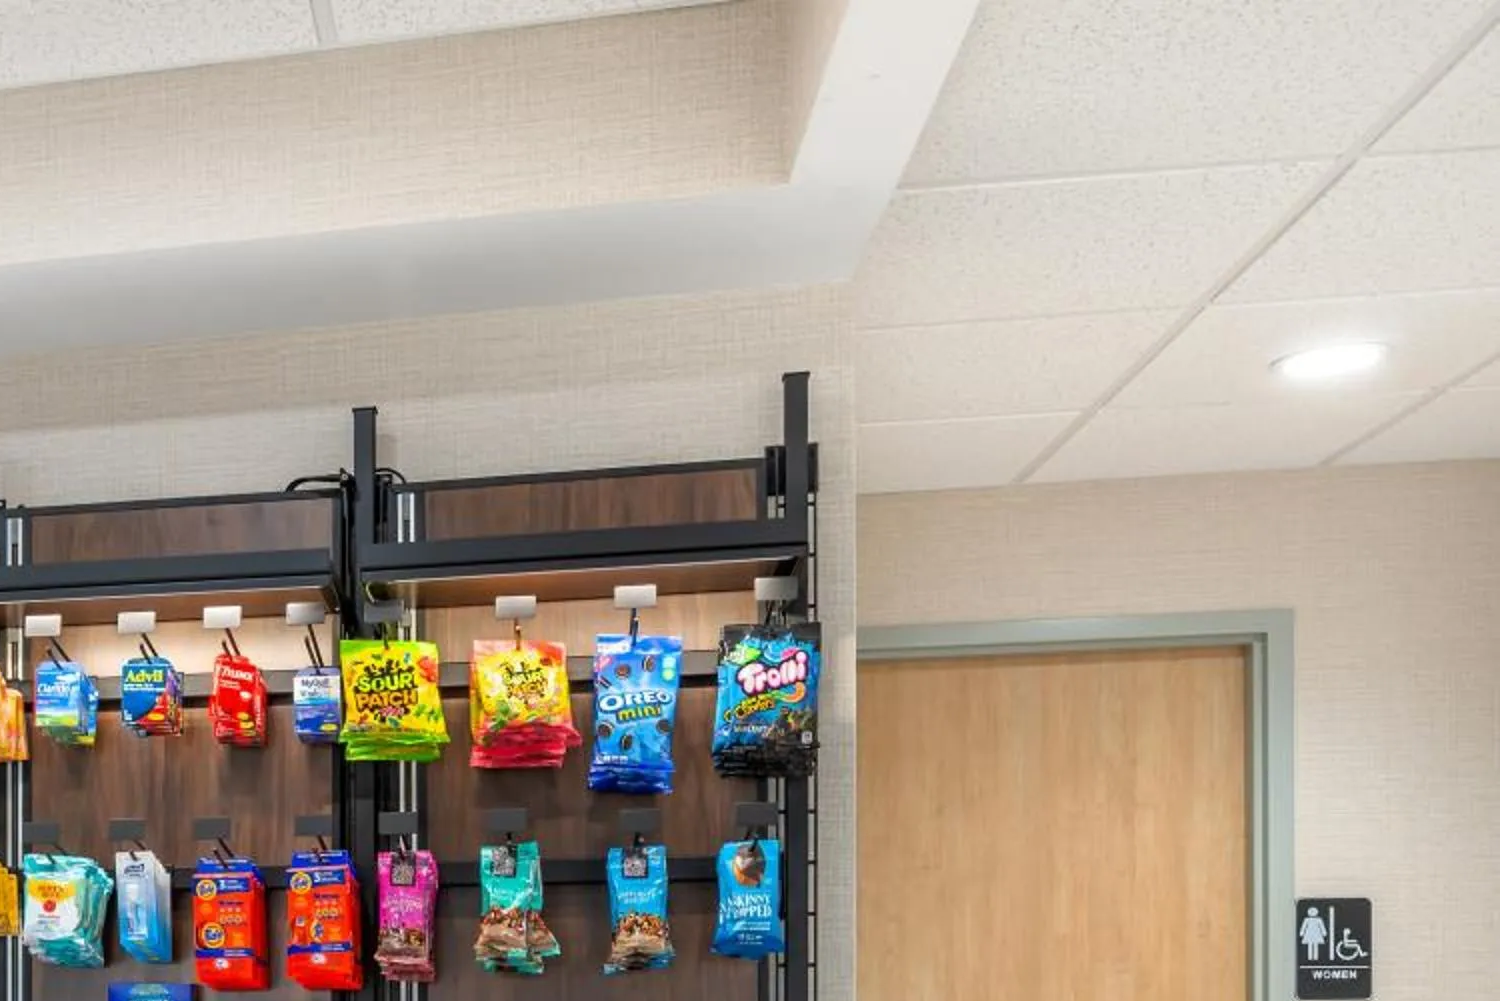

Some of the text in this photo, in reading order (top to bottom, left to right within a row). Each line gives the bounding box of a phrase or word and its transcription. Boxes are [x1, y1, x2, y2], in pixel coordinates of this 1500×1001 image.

[125, 669, 165, 684] Advil
[356, 672, 414, 692] SOUR
[737, 651, 808, 695] Trolli
[355, 690, 417, 708] PATCH
[600, 688, 674, 711] OREO
[617, 704, 662, 723] mini
[1311, 969, 1358, 980] WOMEN
